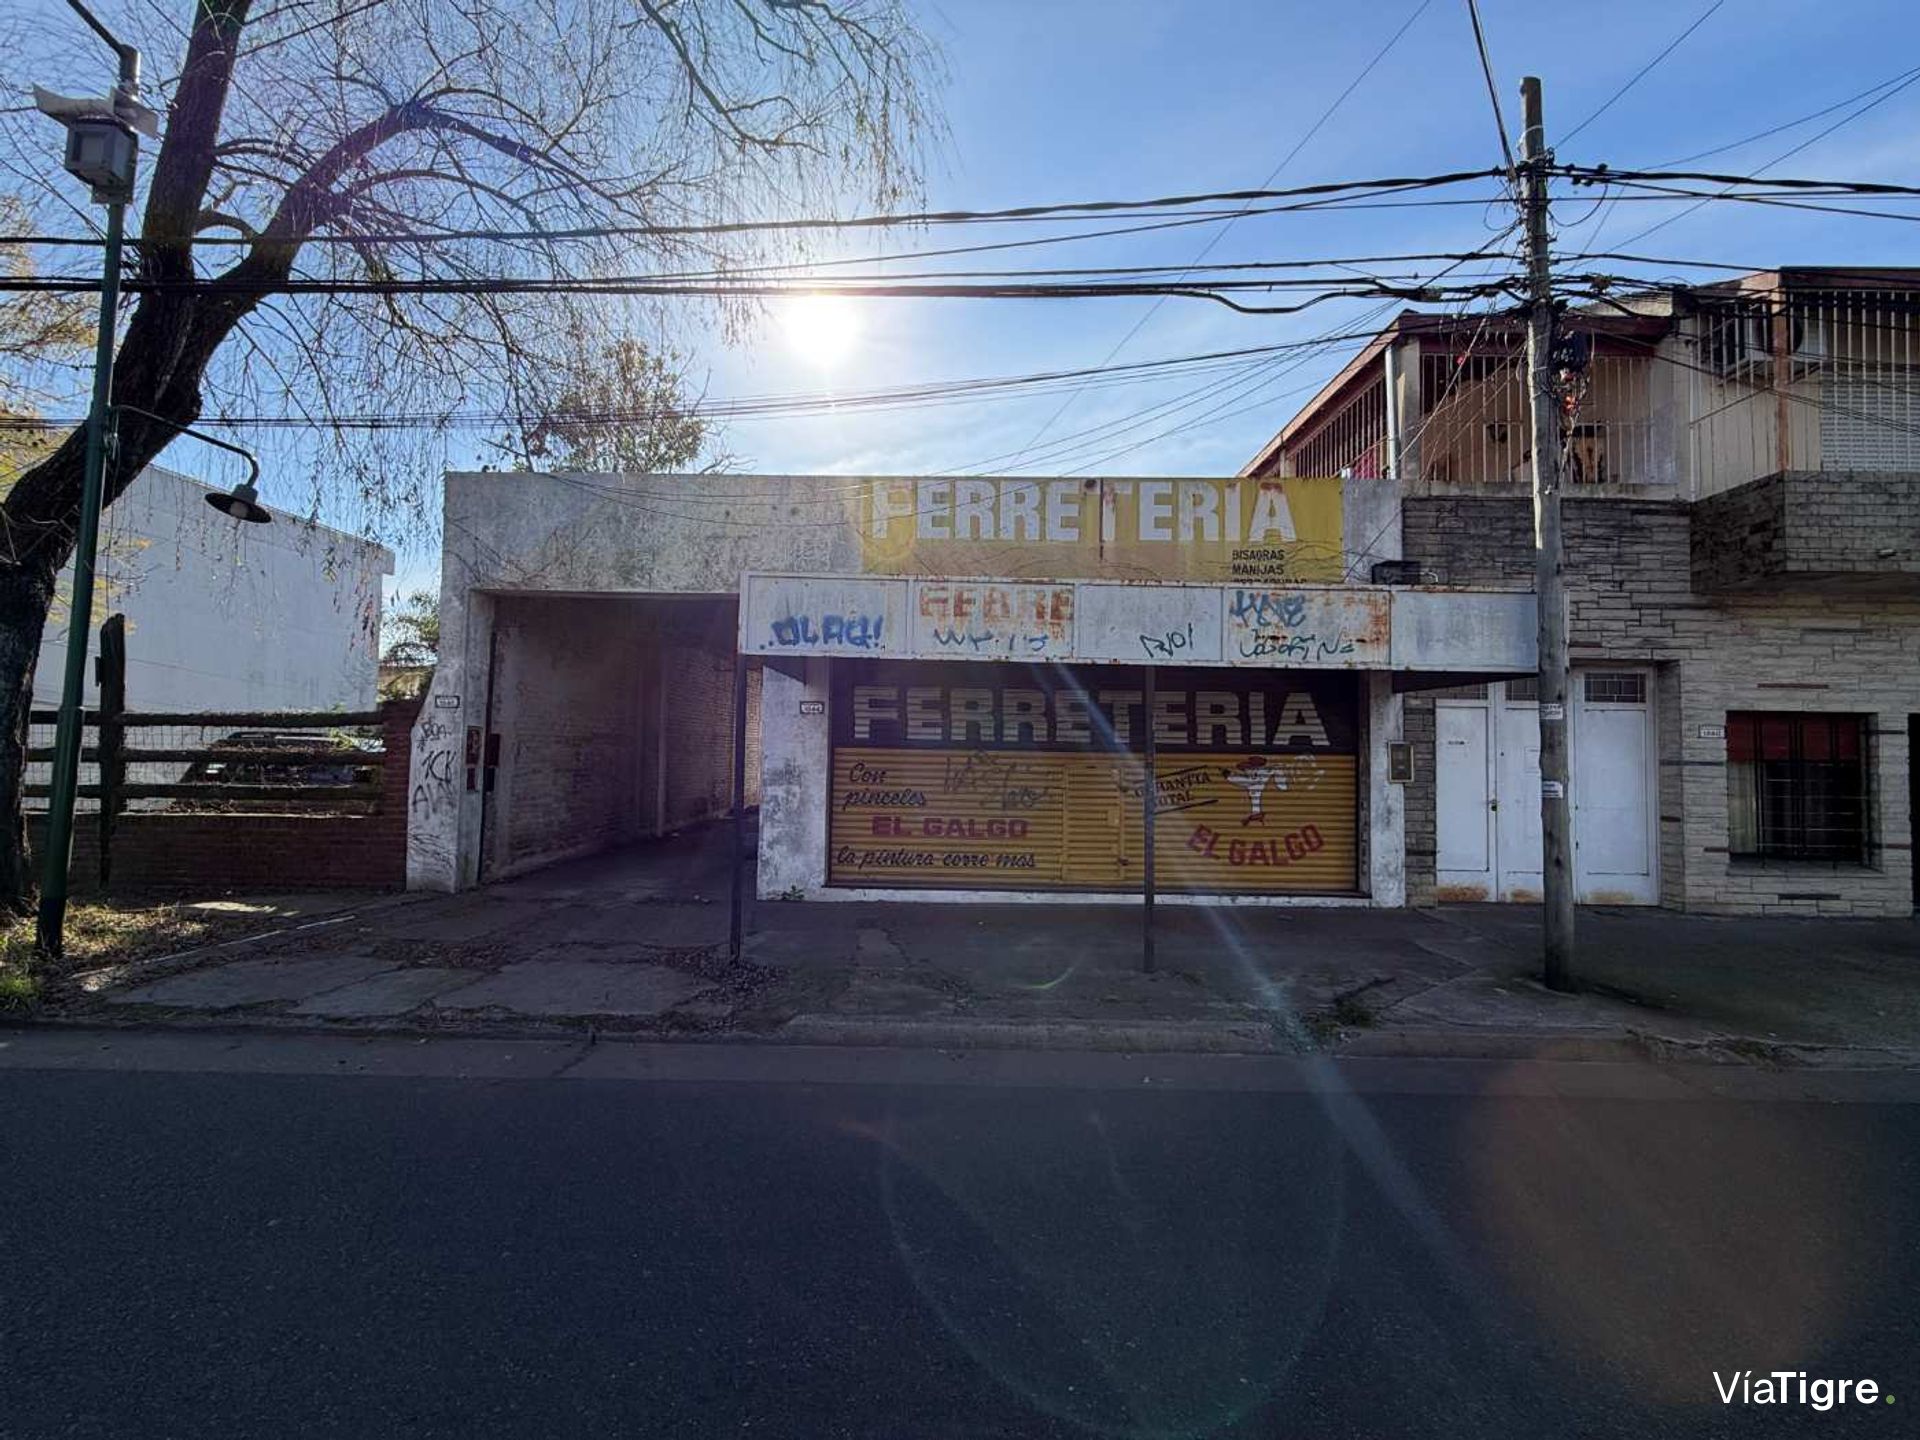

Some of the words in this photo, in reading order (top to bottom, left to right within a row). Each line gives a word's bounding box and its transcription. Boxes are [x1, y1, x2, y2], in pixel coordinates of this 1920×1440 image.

[872, 479, 1297, 542] FERRETERIA
[1232, 549, 1285, 561] BISAGRAS
[1232, 563, 1285, 575] MANIJAS
[854, 686, 1331, 746] FERRETERIA
[850, 762, 887, 783] Con
[842, 788, 927, 811] pinceles
[871, 815, 911, 837] EL
[922, 817, 1030, 839] GALGO
[1185, 824, 1221, 859] EL
[1228, 824, 1325, 867] GALGO
[859, 848, 935, 870] pintura
[943, 852, 989, 868] corre
[996, 852, 1037, 868] mas
